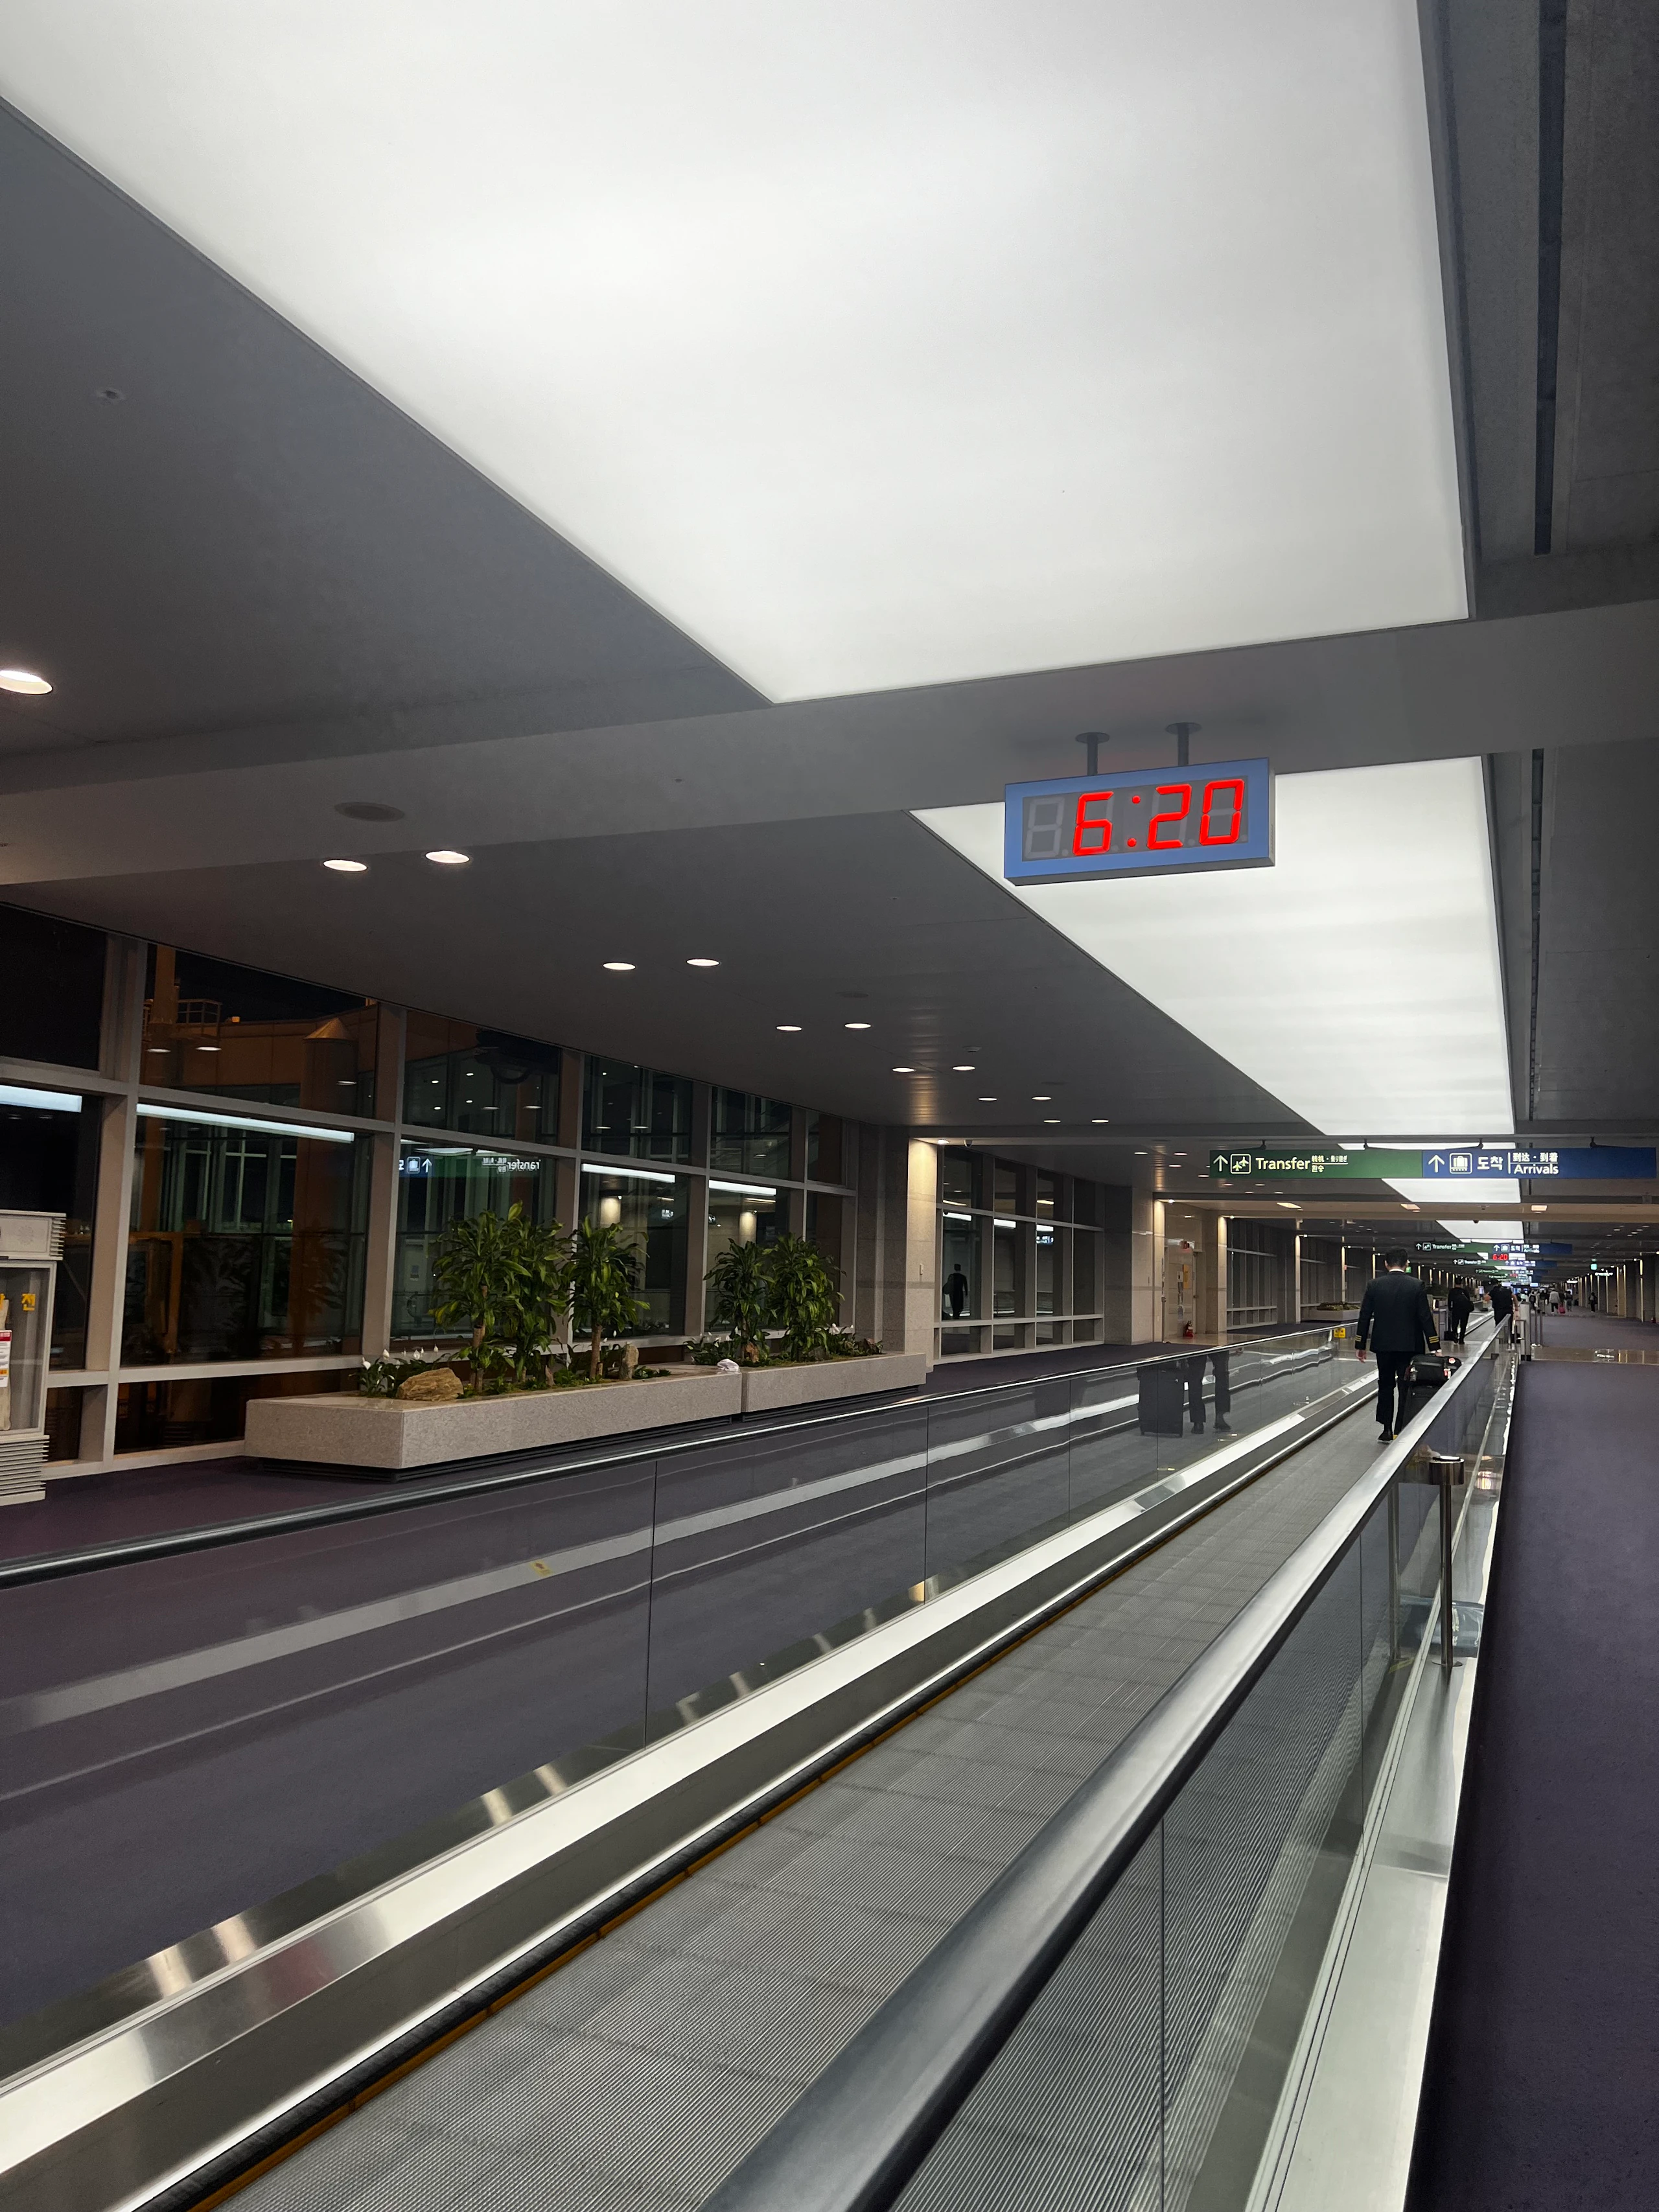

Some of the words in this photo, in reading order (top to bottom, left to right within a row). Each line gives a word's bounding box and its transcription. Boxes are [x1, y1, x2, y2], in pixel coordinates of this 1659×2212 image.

[1073, 778, 1244, 856] 6:20
[1255, 1157, 1311, 1170] Transfer
[1477, 1156, 1503, 1170] 도착
[1513, 1163, 1559, 1174] Arrivals
